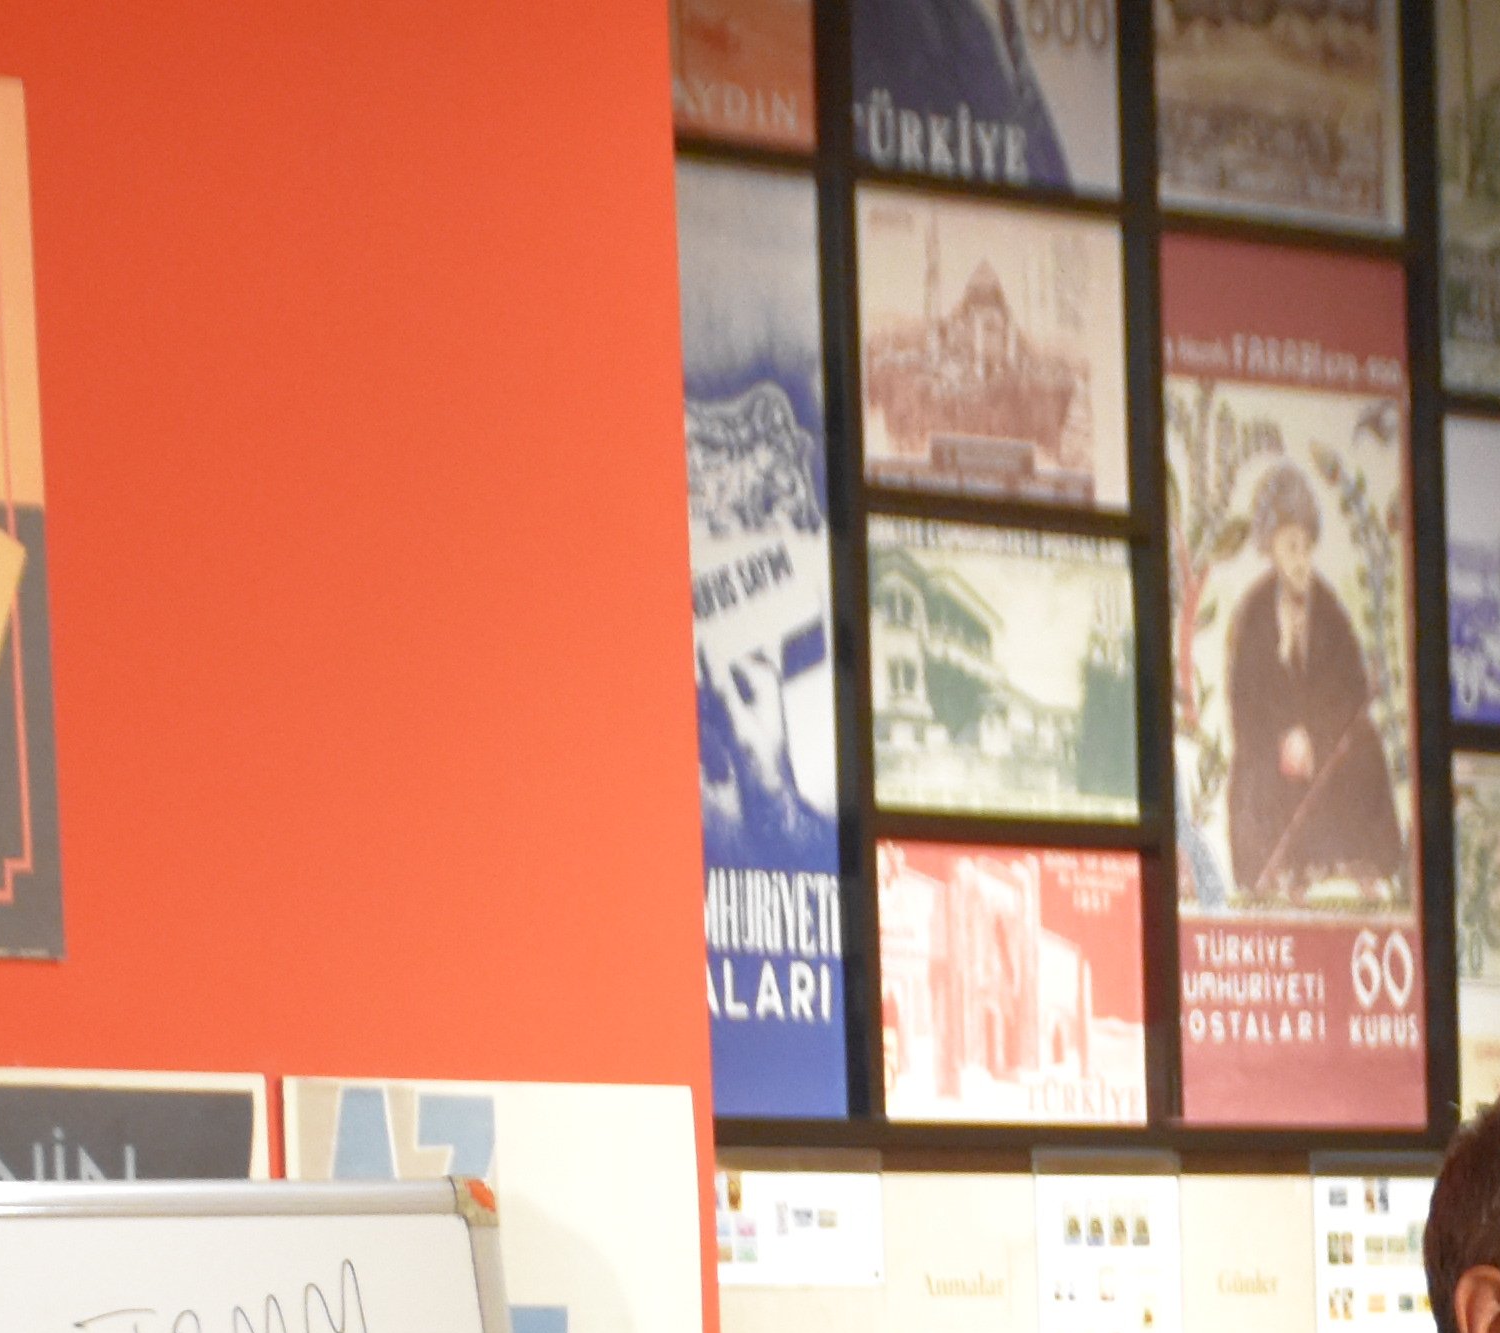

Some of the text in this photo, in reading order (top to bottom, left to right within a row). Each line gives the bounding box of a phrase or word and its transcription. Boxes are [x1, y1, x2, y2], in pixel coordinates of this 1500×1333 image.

[854, 88, 1029, 180] ÜRKİYE
[1193, 928, 1414, 1007] TÜRKİYE 60
[1181, 1003, 1327, 1042] OSTALARI
